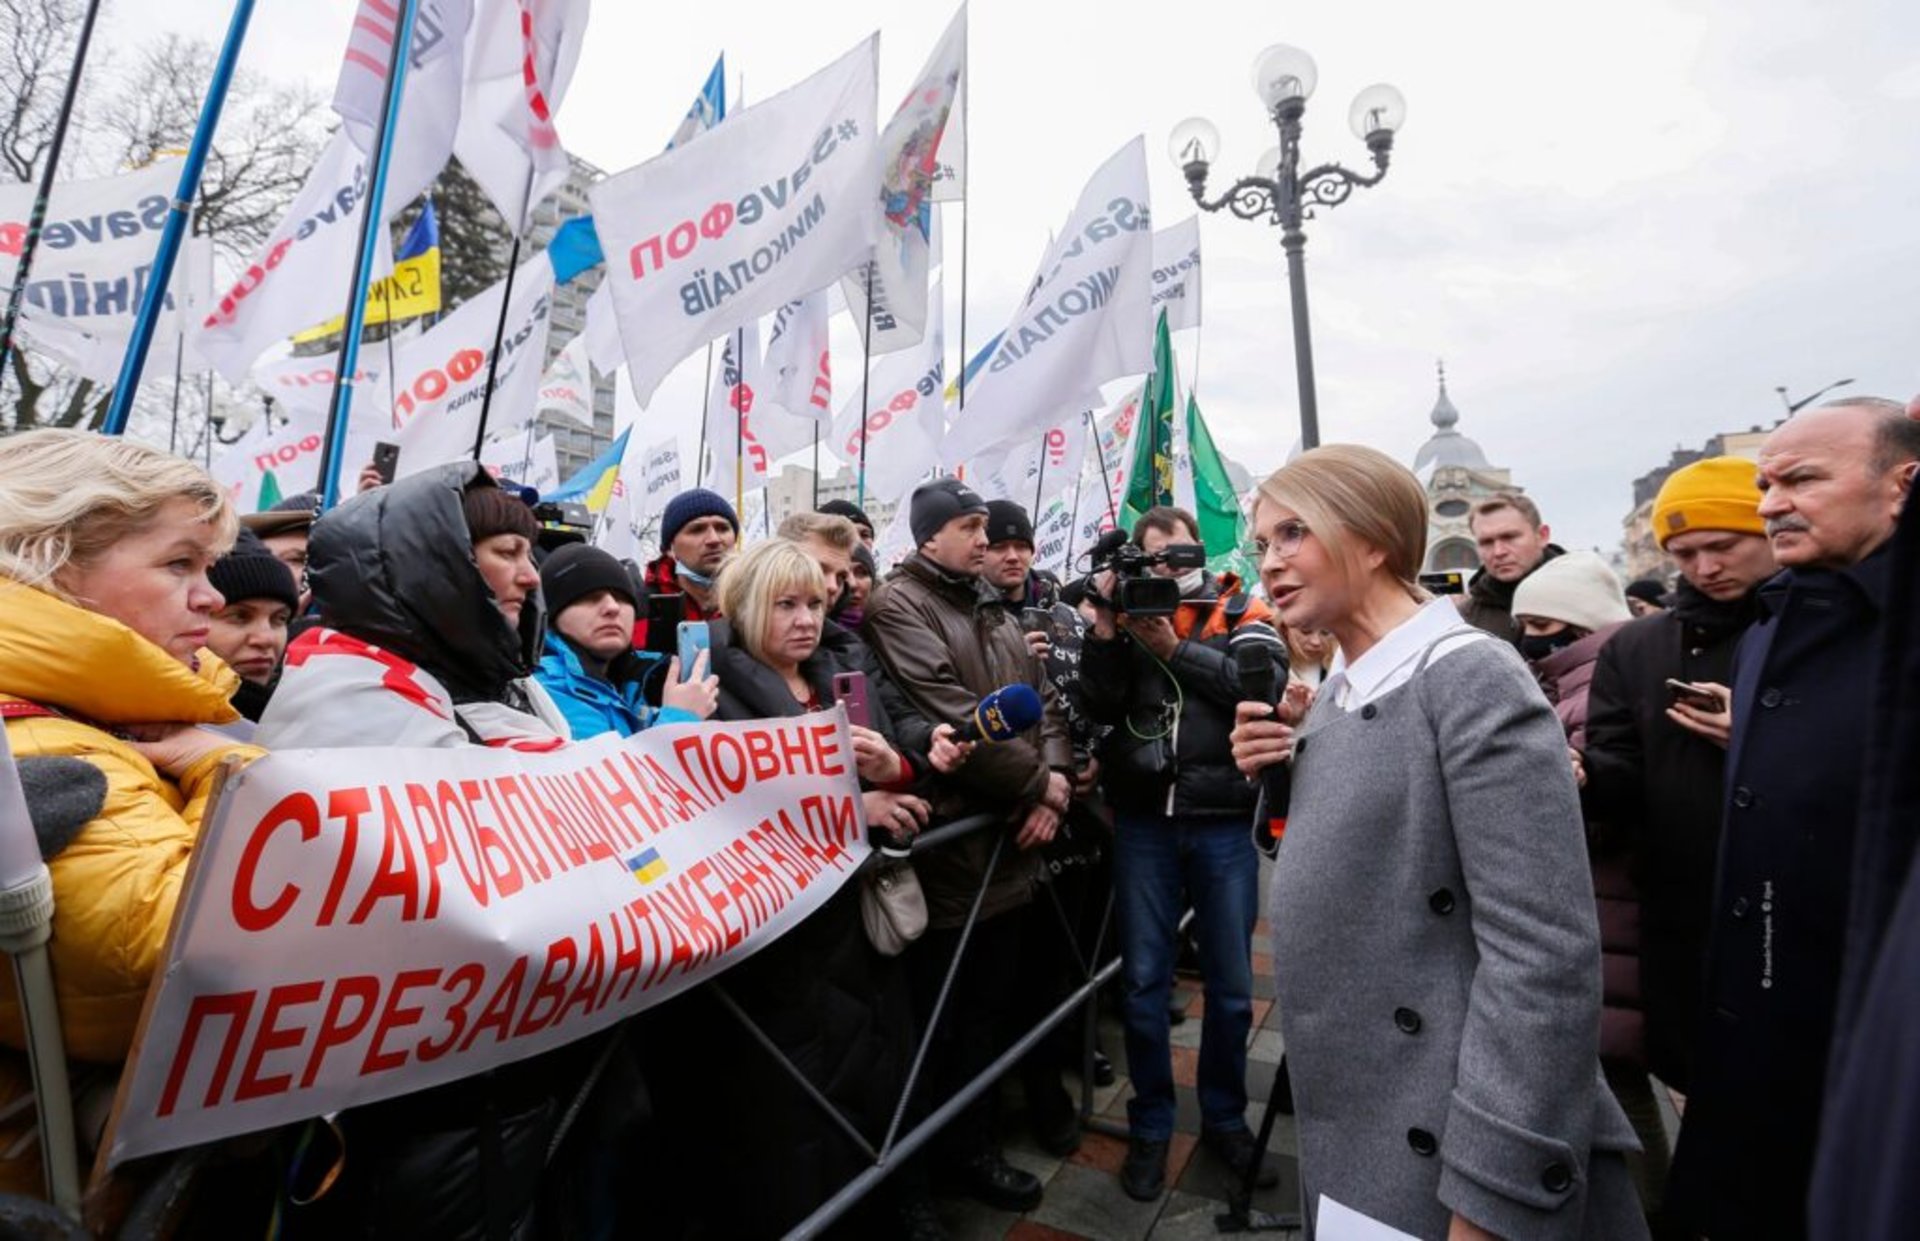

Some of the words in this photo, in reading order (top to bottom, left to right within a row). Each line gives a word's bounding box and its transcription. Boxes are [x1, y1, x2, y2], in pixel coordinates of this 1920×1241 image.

[156, 838, 794, 1118] ПЕРЕЗАВАНТАЖЕННЯ
[748, 796, 859, 890] ВЛАДИ
[232, 751, 669, 931] СТАРОБІЛЬЩИНА
[673, 724, 844, 803] ПОВНЕ
